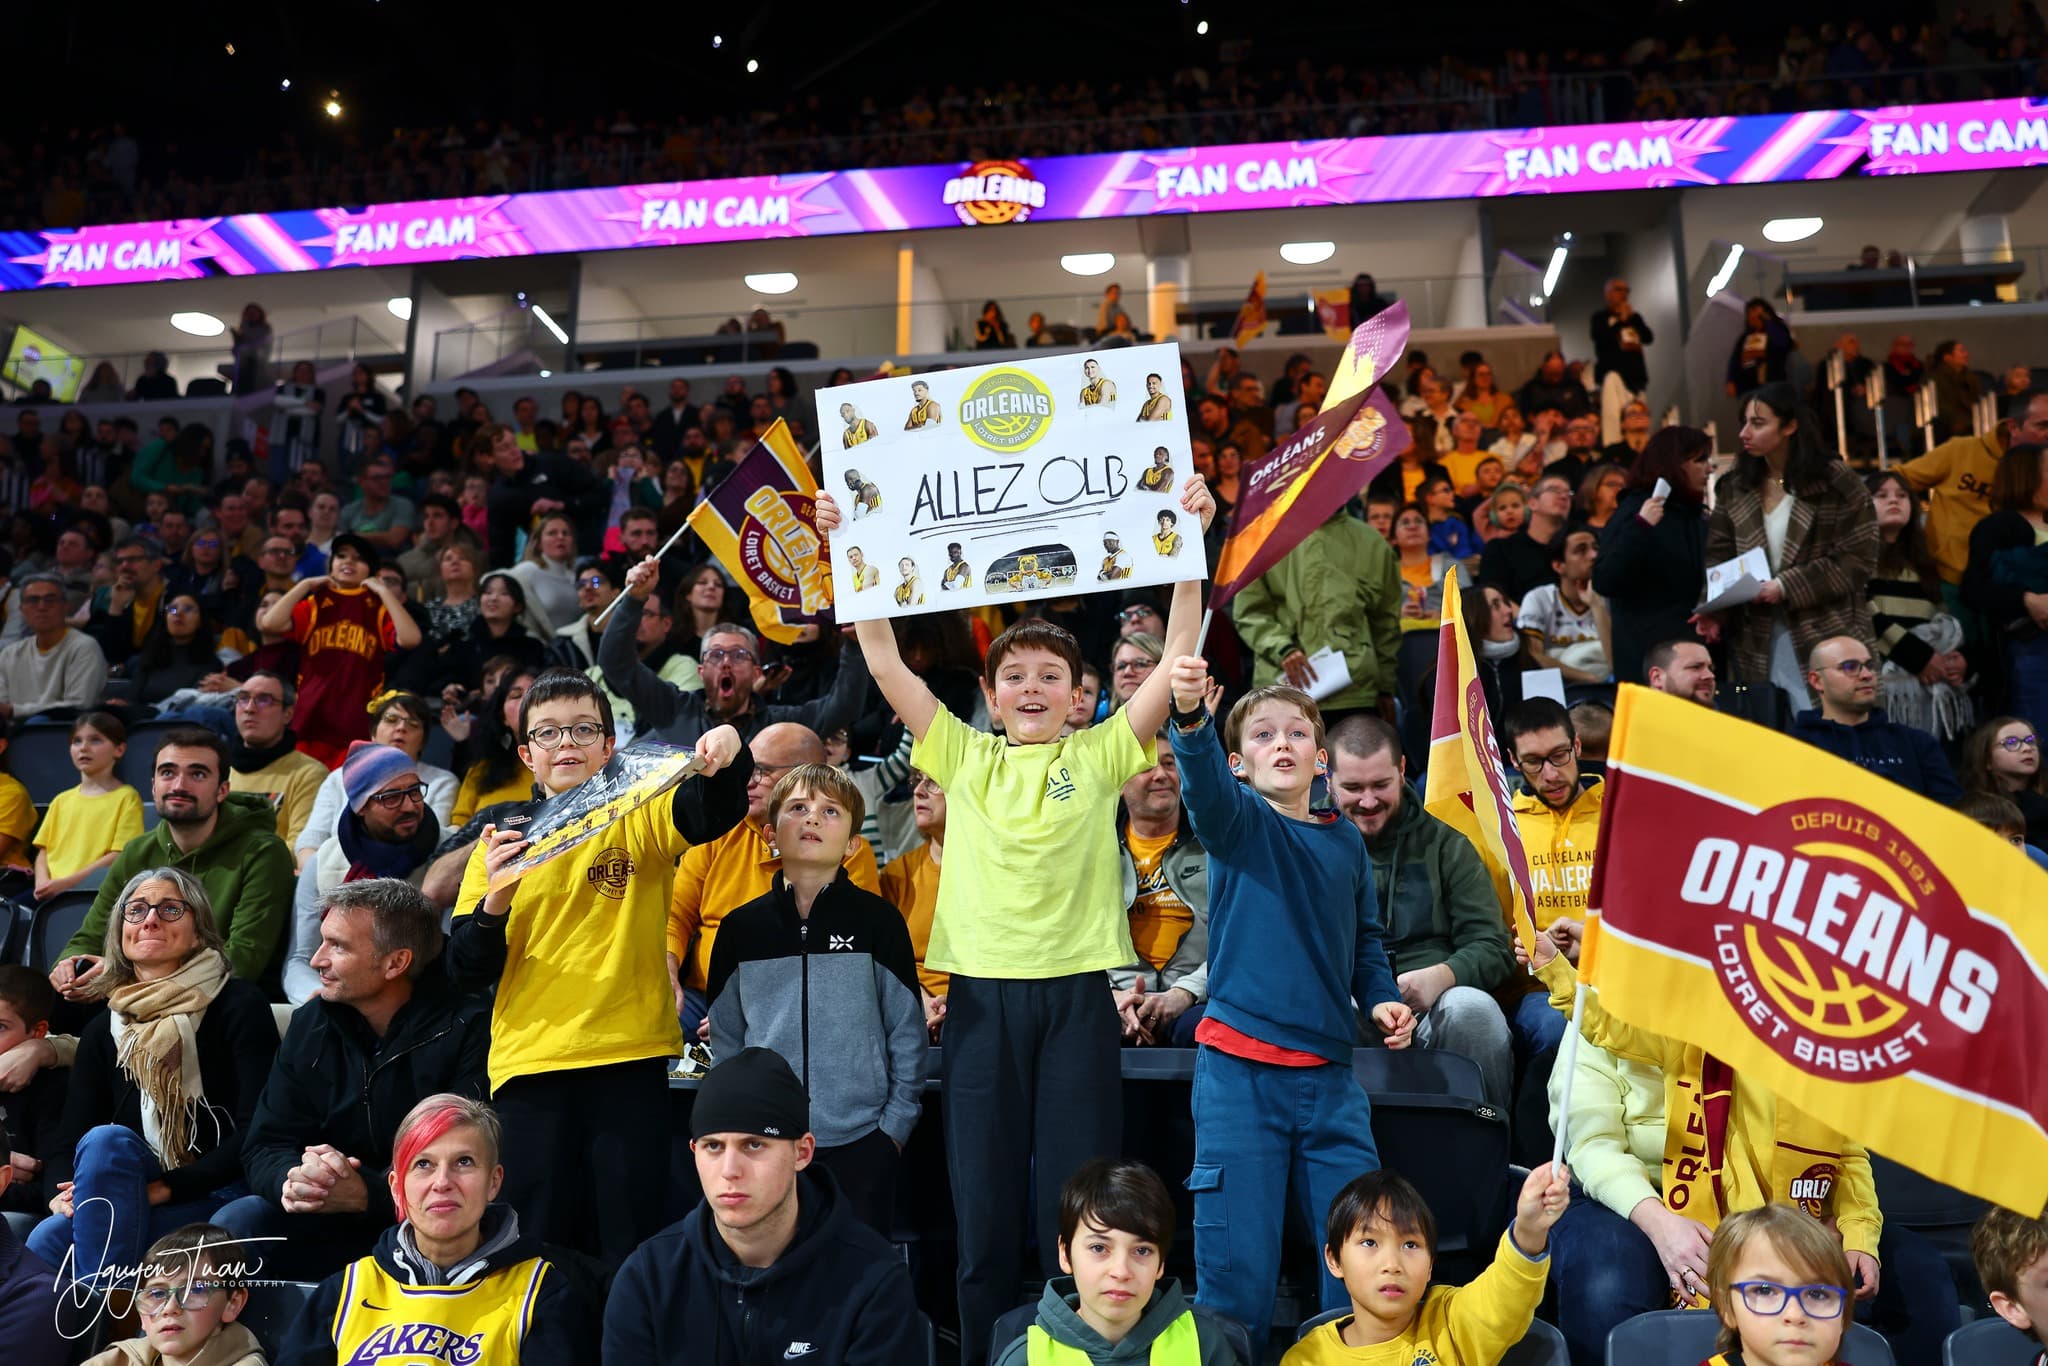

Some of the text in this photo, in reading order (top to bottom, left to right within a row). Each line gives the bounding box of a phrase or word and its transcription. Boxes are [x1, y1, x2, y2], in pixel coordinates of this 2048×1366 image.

[1870, 117, 2048, 158] FAN CAM
[1156, 157, 1318, 199] FAN CAM
[1504, 136, 1673, 182] FAN CAM
[641, 195, 790, 231] FAN CAM
[46, 238, 181, 273] FAN CAM
[334, 216, 477, 255] FAN CAM
[962, 391, 1050, 423] ORLÉANS
[974, 419, 1041, 444] LOIRET BASKET
[1249, 425, 1327, 487] ORLÉANS
[910, 455, 1128, 526] ALLEZ OLB
[747, 530, 795, 601] LOIRET BASKET
[1790, 813, 1937, 897] DEPUIS 1993
[1680, 836, 1999, 1035] ORLÉANS
[1713, 924, 1930, 1073] LOIRET BASKET
[344, 1323, 485, 1366] LAKERS
[789, 1341, 811, 1353] NIKE
